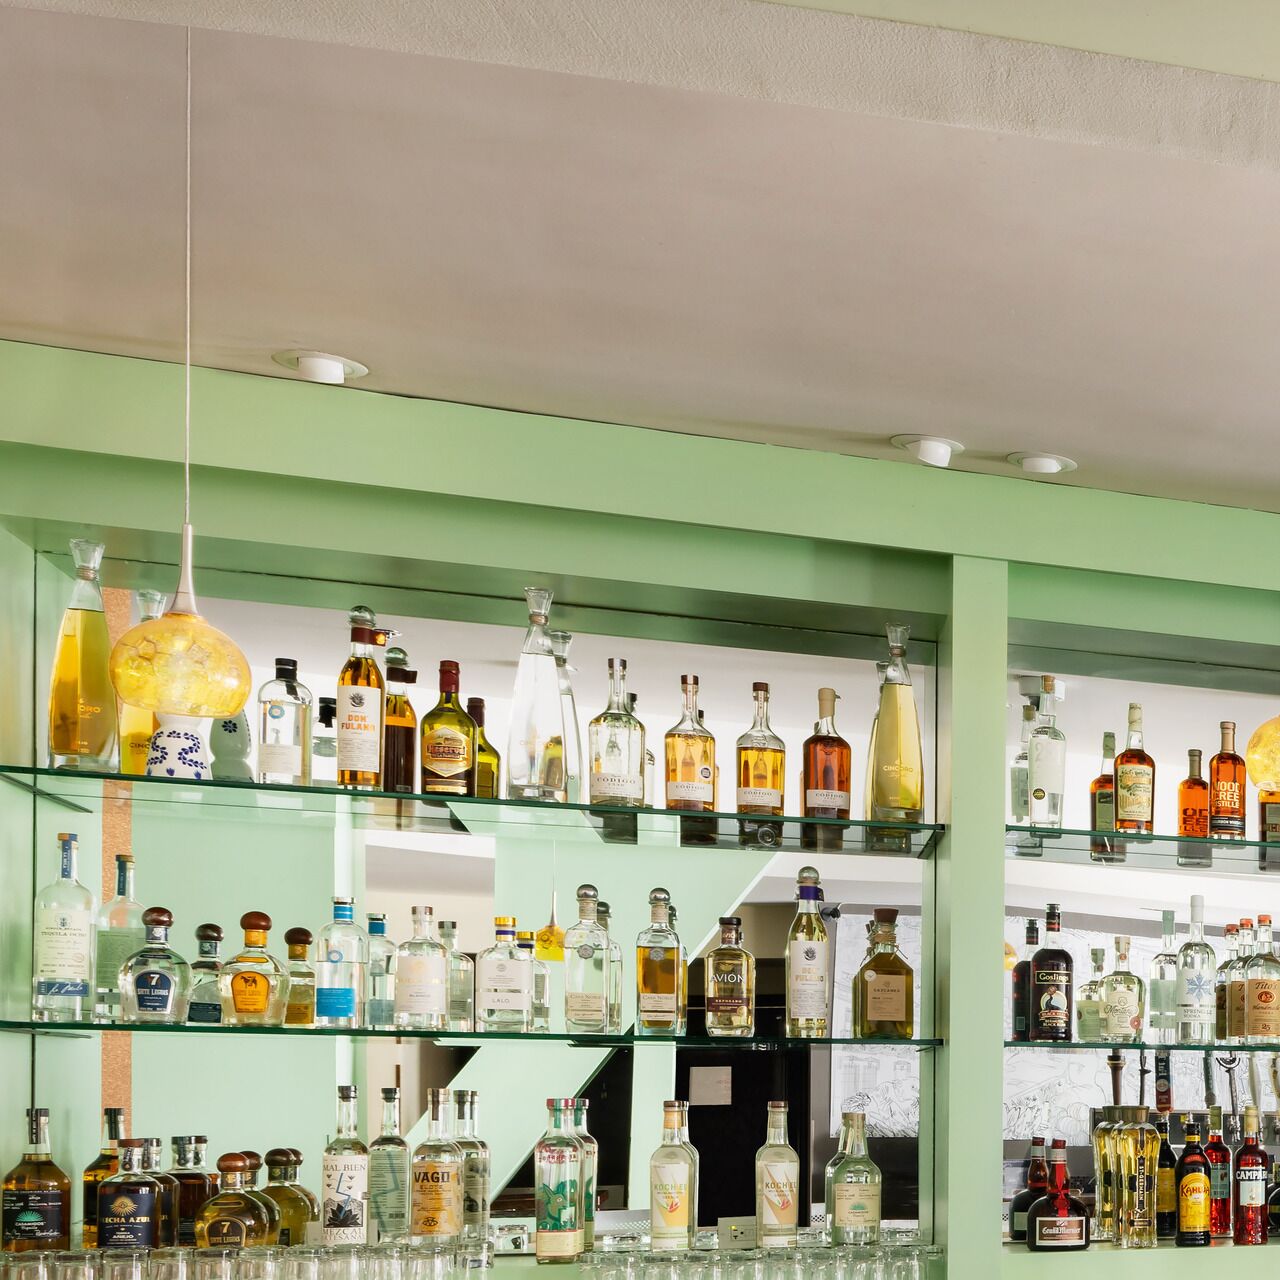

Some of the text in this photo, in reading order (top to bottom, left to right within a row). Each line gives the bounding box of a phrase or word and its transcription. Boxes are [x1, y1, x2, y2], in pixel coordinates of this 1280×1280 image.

[150, 974, 160, 985] 7
[414, 1172, 450, 1183] VAGO
[221, 1222, 230, 1233] 7
